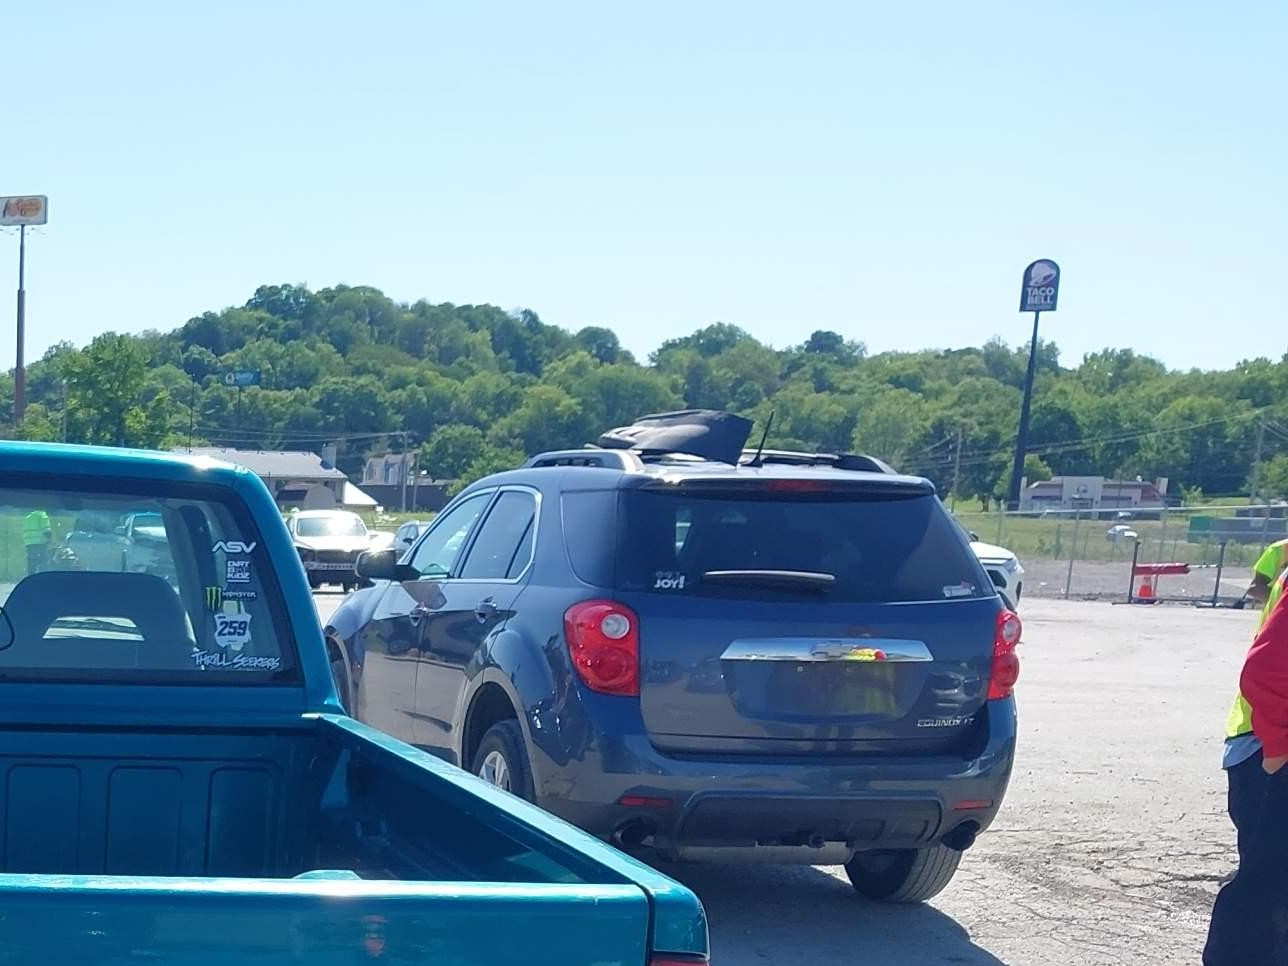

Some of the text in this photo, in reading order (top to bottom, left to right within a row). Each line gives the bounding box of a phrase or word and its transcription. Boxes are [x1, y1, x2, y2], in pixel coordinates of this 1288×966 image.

[1025, 287, 1055, 296] TACO
[1027, 295, 1054, 304] BELL
[212, 541, 257, 554] ASV
[653, 575, 686, 589] JOY!
[222, 591, 257, 599] MONSTER
[217, 620, 249, 637] 259
[192, 650, 233, 667] THRILL
[916, 719, 961, 728] EQUINOX
